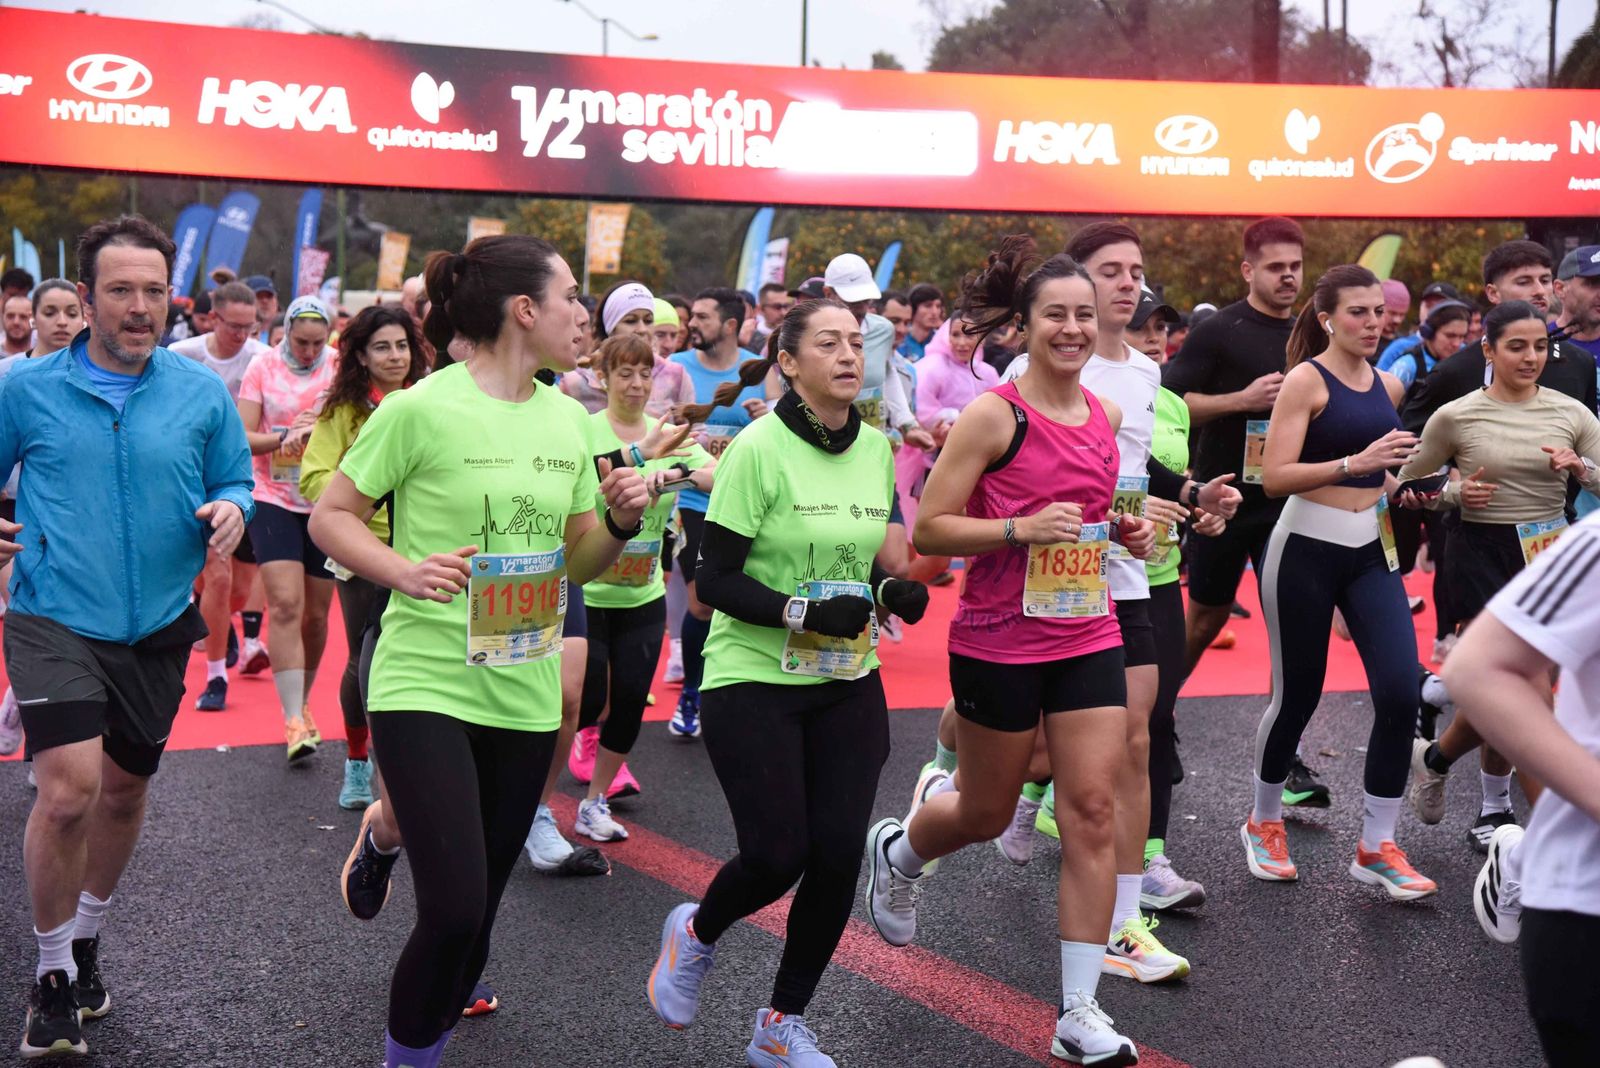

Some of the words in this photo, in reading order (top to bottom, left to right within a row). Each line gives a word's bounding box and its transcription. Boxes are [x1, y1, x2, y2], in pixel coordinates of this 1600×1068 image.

[49, 98, 170, 128] HYUNDAI
[198, 78, 357, 134] HOKA
[621, 126, 780, 169] sevilla
[993, 120, 1120, 165] HOKA
[1448, 136, 1559, 166] Sprinter
[1141, 155, 1230, 177] HYUNDAI
[463, 457, 493, 465] Masajes
[494, 457, 514, 465] Albert
[547, 459, 576, 471] FERGO
[793, 503, 819, 513] Masajes
[821, 503, 839, 512] Albert
[1038, 547, 1103, 577] 18325
[482, 576, 561, 616] 11916
